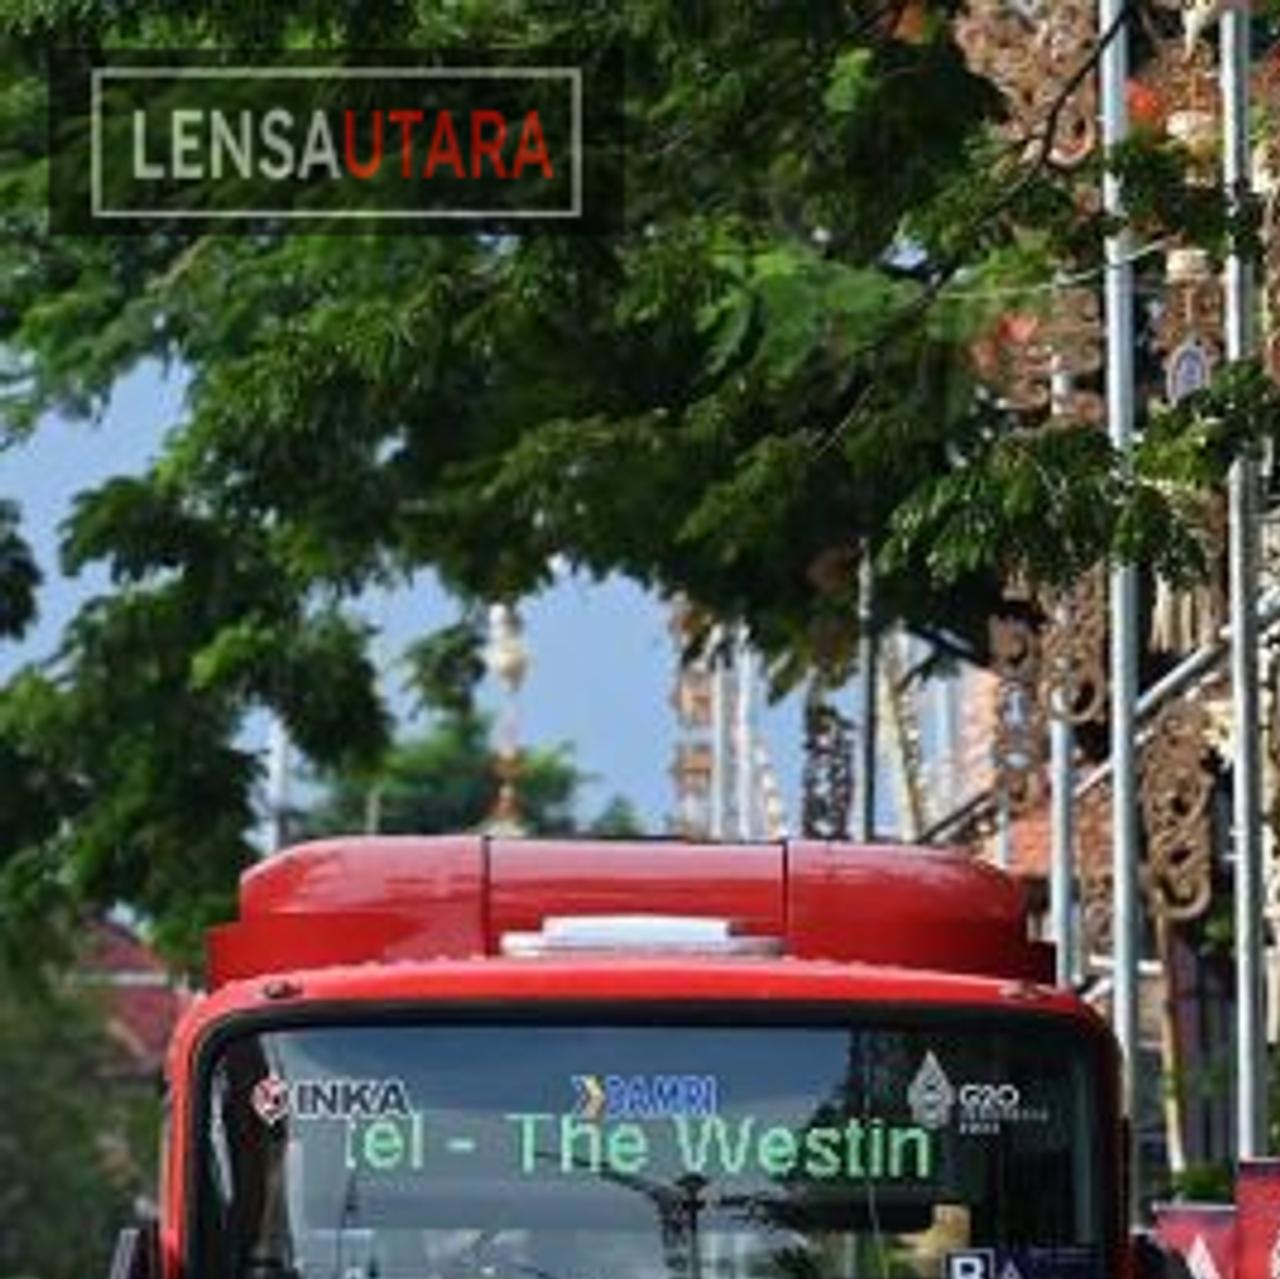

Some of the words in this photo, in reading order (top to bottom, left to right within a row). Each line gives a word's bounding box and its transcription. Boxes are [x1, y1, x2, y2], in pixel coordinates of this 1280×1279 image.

[295, 1079, 412, 1117] INKA
[505, 1113, 648, 1174] The
[672, 1114, 930, 1177] Westin
